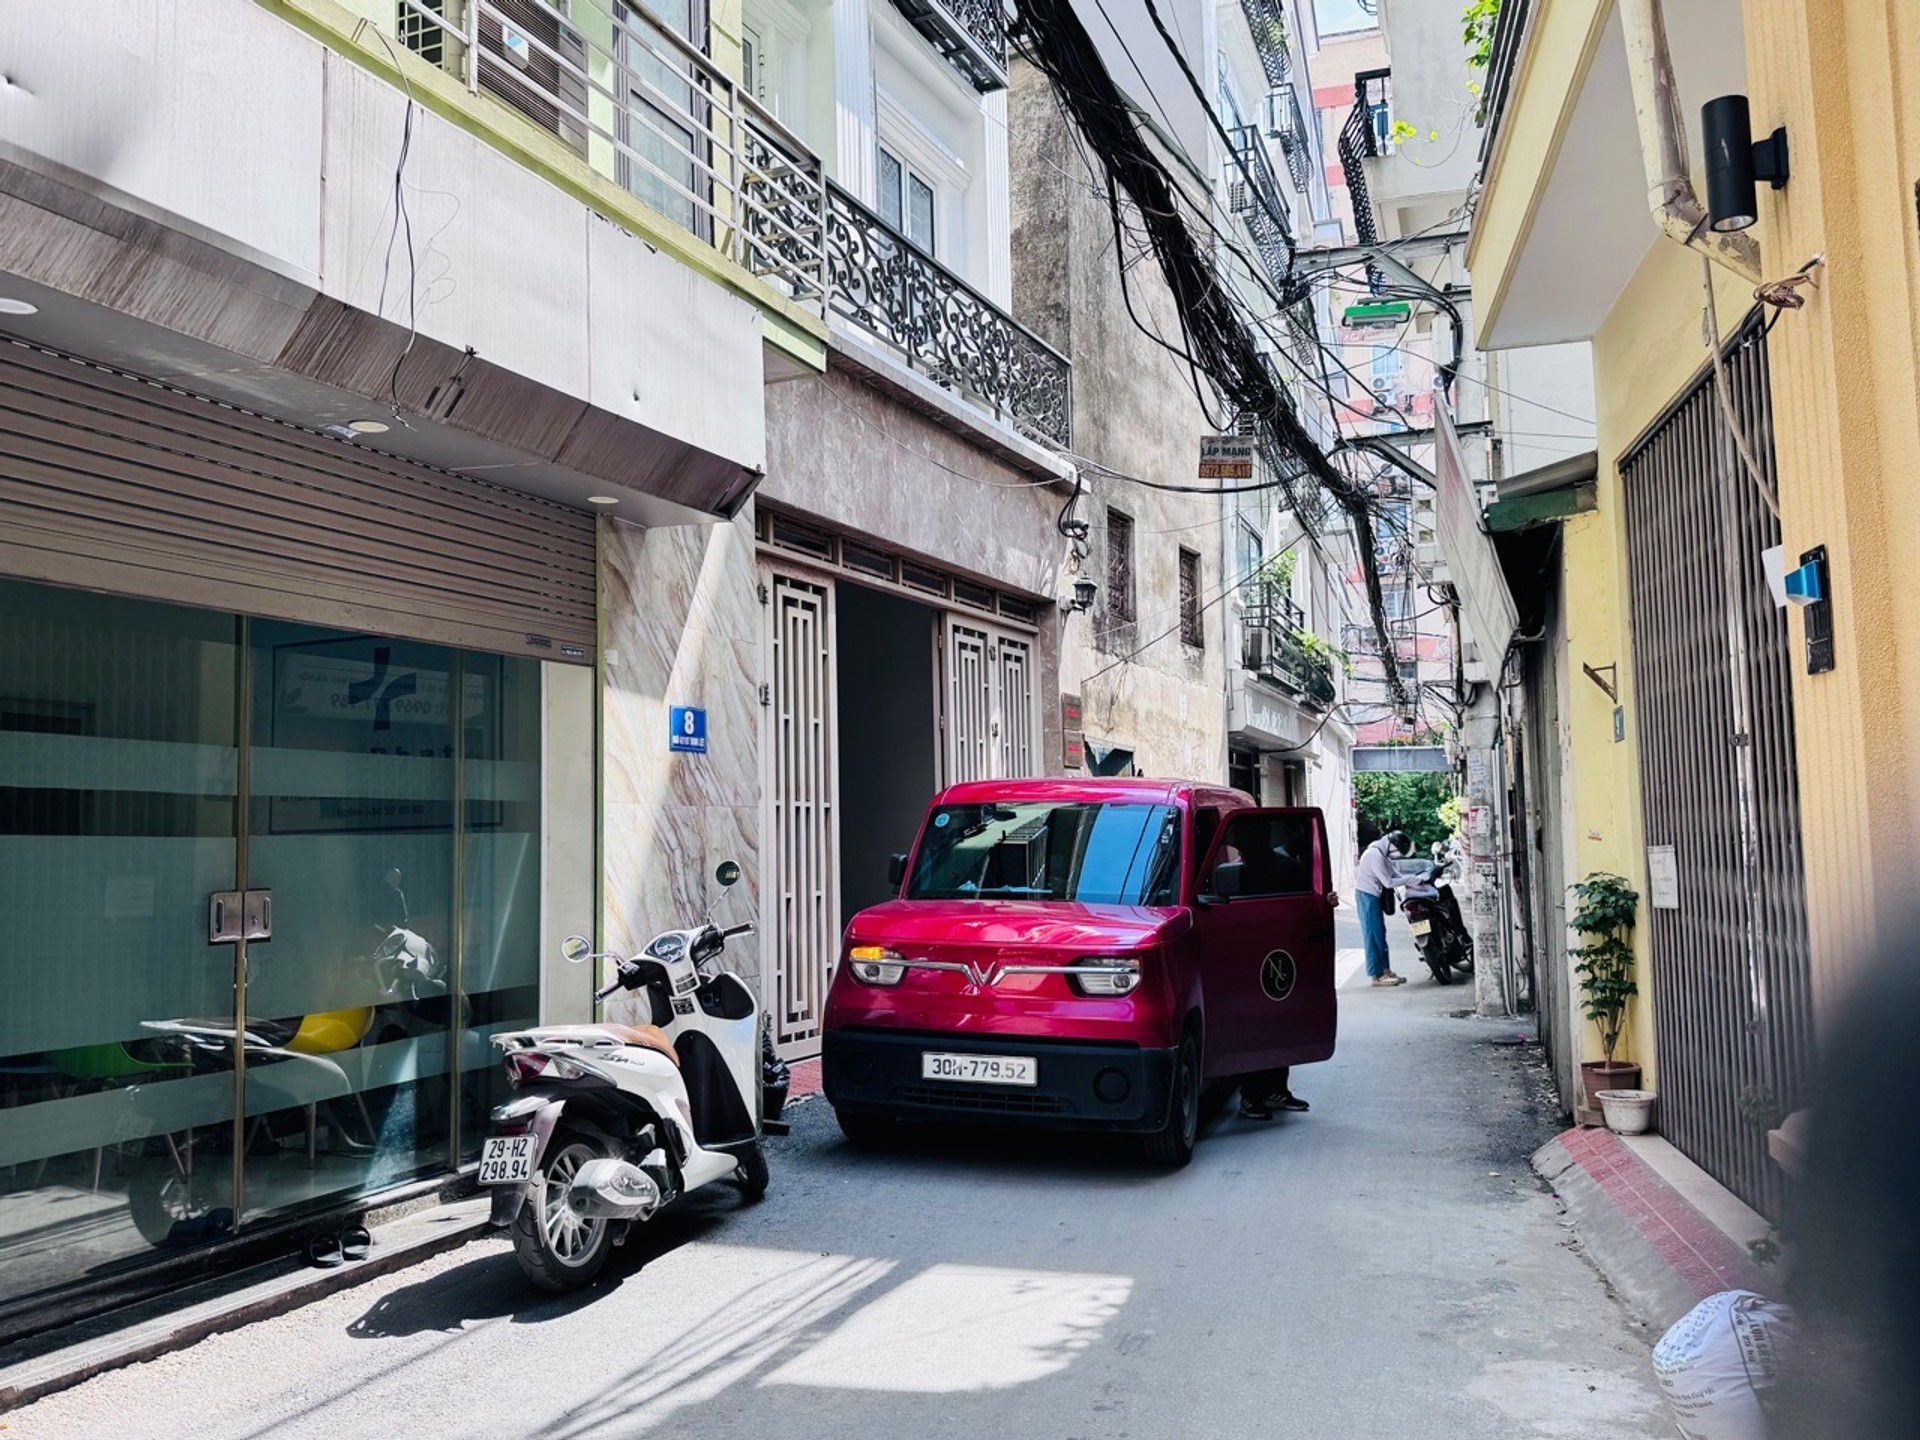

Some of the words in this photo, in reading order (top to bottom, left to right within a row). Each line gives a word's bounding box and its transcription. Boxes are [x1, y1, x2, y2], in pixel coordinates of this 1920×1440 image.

[684, 710, 695, 735] 8
[489, 1139, 528, 1159] 29-H2
[481, 1160, 528, 1180] 298.94
